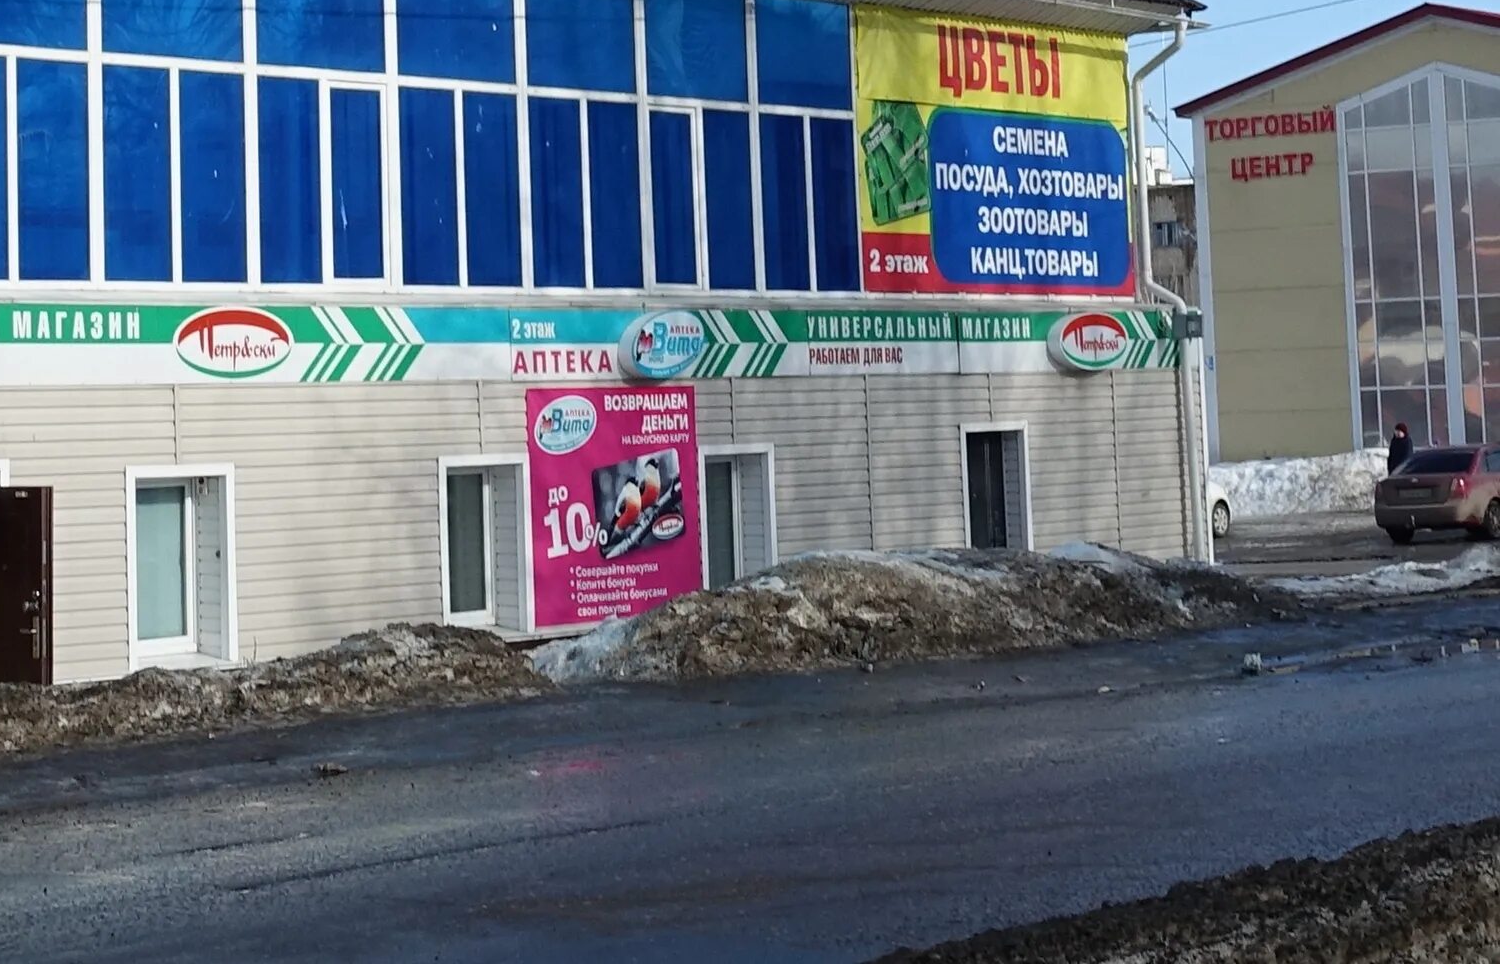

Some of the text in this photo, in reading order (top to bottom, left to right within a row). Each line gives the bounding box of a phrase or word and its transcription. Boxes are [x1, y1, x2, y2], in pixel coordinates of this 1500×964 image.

[936, 24, 1061, 99] ЦВЕТЫ
[1204, 104, 1336, 142] ТОРГОВЫЙ
[993, 126, 1069, 158] СЕМЕНА
[1231, 152, 1314, 182] ЦЕНТР
[935, 162, 1124, 201] ПОСУДА, ХОЗТОВАРЫ
[978, 206, 1088, 237] ЗООТОВАРЫ
[869, 249, 929, 274] 2 этаж
[971, 246, 1098, 280] КАНЦ.ТОВАРЫ
[12, 310, 140, 339] МАГАЗИН
[512, 319, 556, 340] 2 этаж
[670, 325, 700, 334] АПТЕКА
[807, 312, 1031, 339] УНИВЕРСАЛЬНЫЙ МАГАЗИН
[652, 322, 702, 356] Вита
[513, 350, 613, 374] АПТЕКА
[809, 347, 903, 366] РАБОТАЕМ ДЛЯ ВАС
[603, 392, 688, 412] ВОЗВРАЩАЕМ
[641, 413, 689, 434] ДЕНЬГИ
[621, 434, 632, 444] НА
[670, 432, 690, 443] КАРТУ
[544, 502, 608, 559] 10%
[575, 563, 659, 578] Совершайте покупки
[576, 577, 636, 591] Копите бонусы
[629, 587, 668, 601] бонусами
[577, 607, 597, 616] свои
